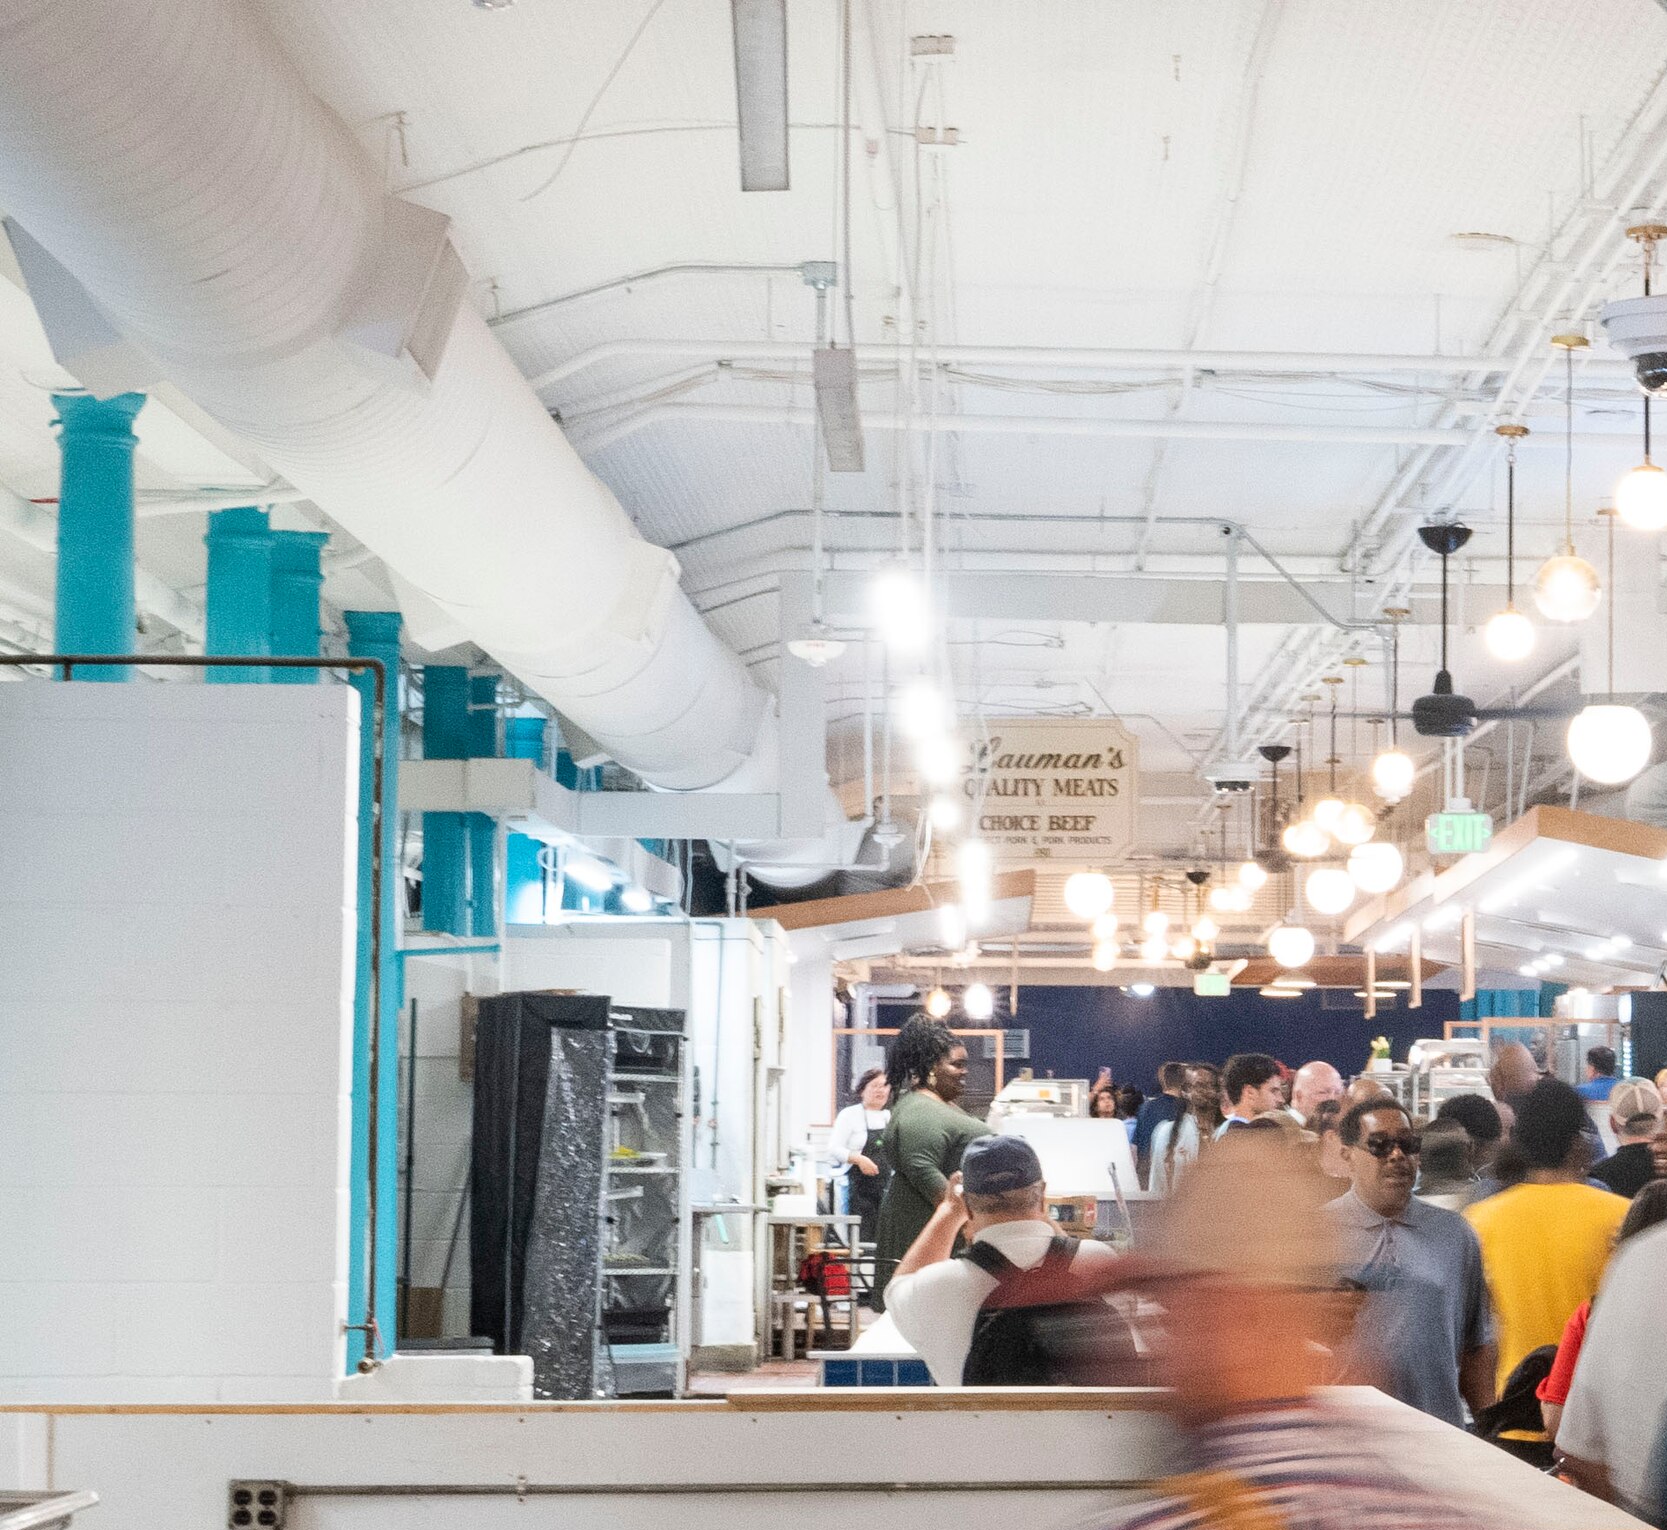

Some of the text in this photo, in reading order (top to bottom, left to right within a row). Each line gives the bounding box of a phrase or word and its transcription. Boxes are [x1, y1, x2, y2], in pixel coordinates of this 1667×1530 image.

[1053, 778, 1119, 797] MEATS
[979, 815, 1097, 831] CHOICE BEEF
[1069, 836, 1112, 845] PRODUCTS
[1439, 815, 1485, 851] EXIT
